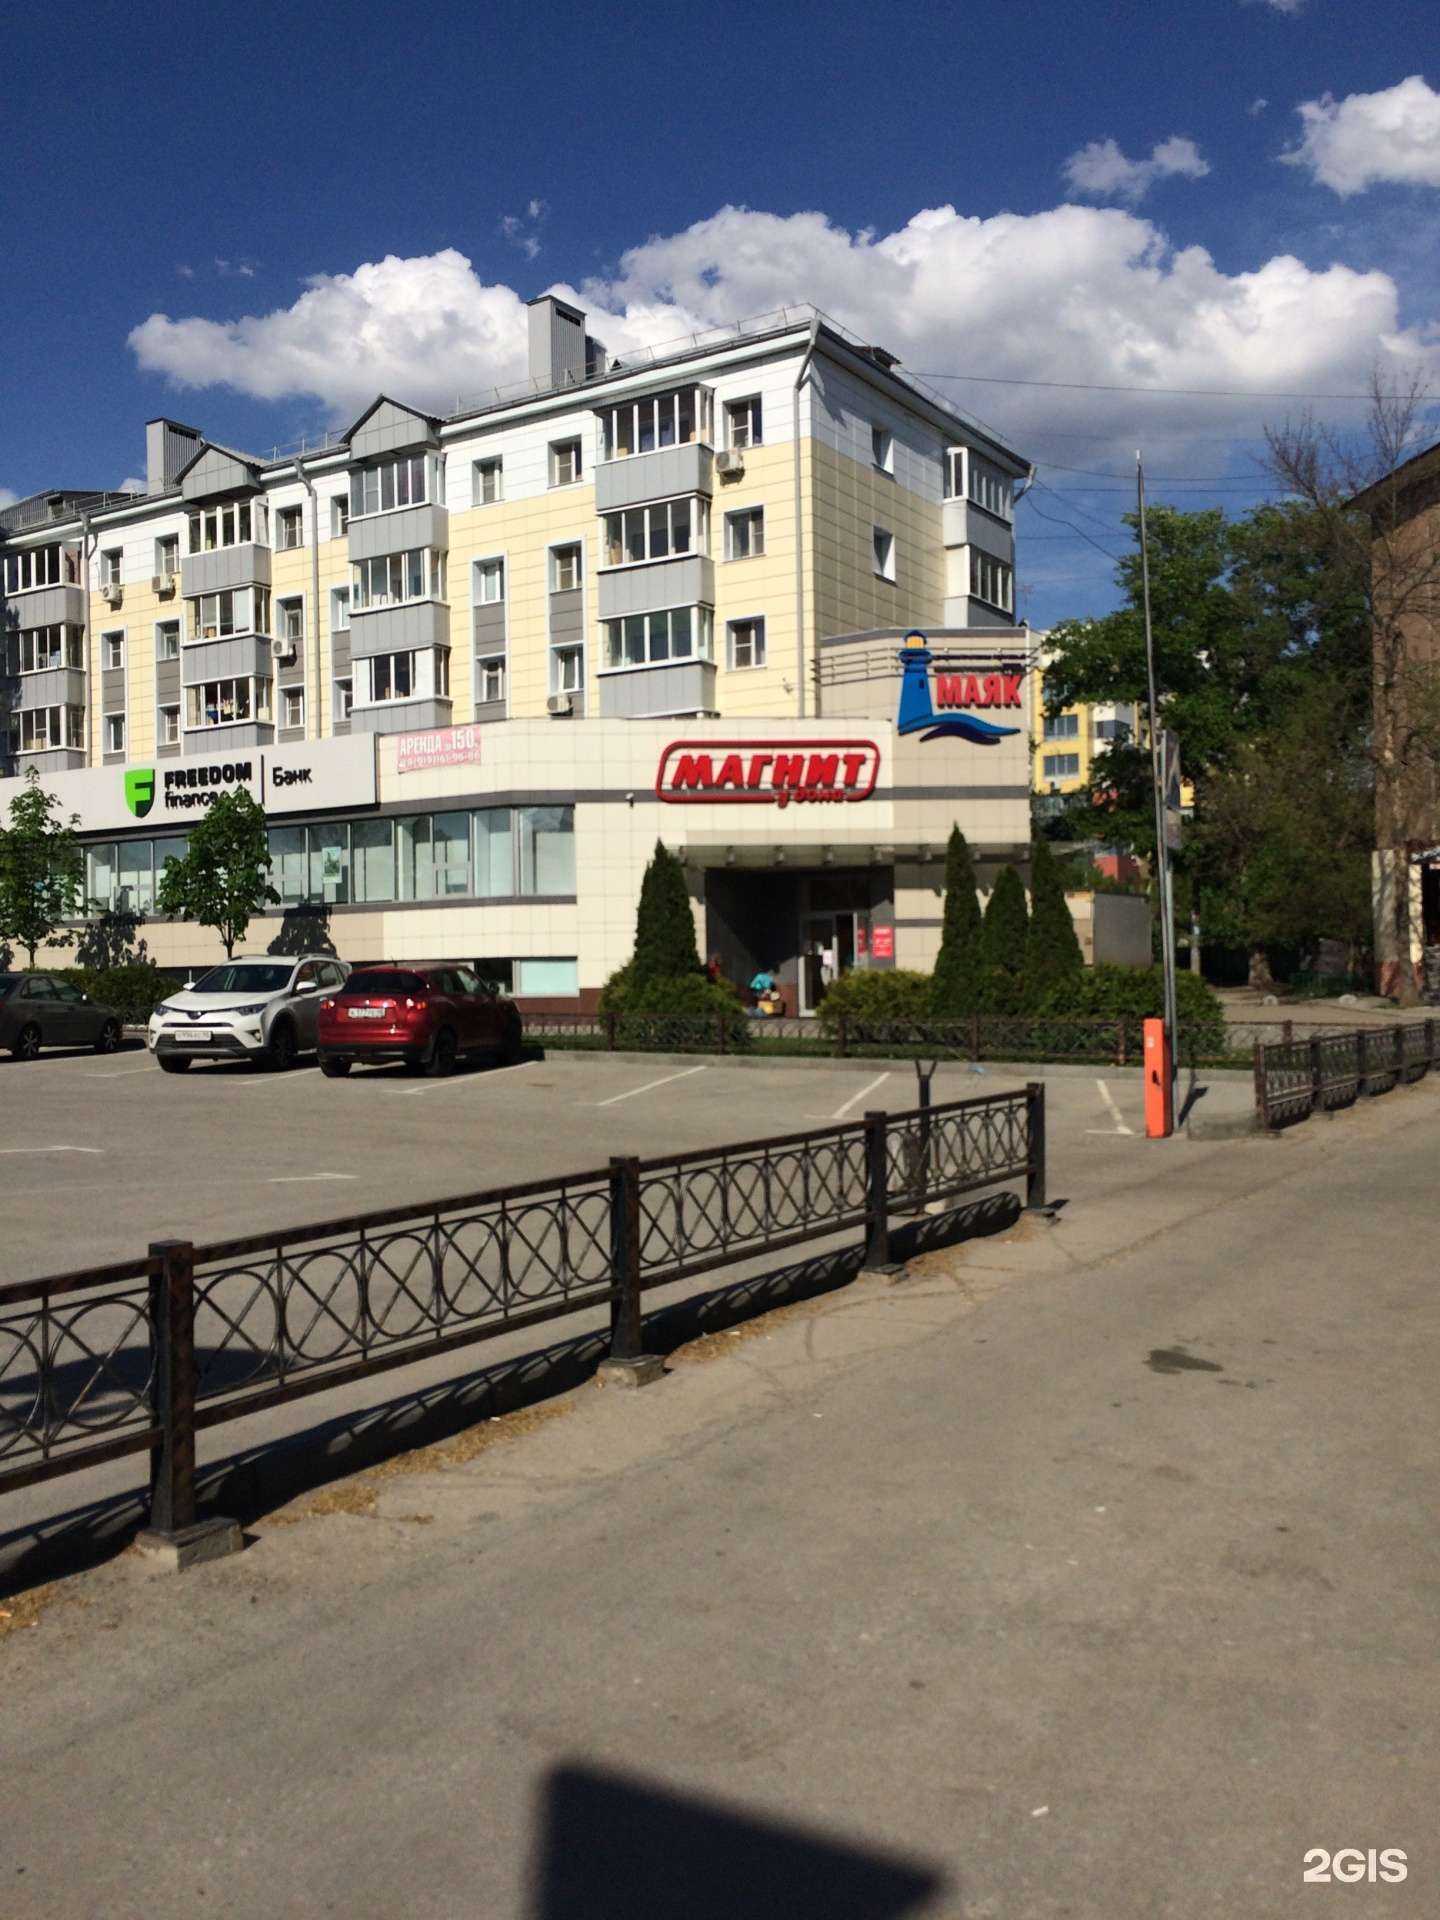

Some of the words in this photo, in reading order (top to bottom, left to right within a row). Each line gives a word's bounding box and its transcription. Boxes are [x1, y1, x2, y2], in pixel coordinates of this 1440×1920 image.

[936, 672, 1022, 709] МАЯК
[399, 735, 442, 757] АРЕНДА
[164, 761, 252, 790] FREEDOM
[272, 767, 313, 787] Банк
[671, 754, 867, 790] МАГНИТ
